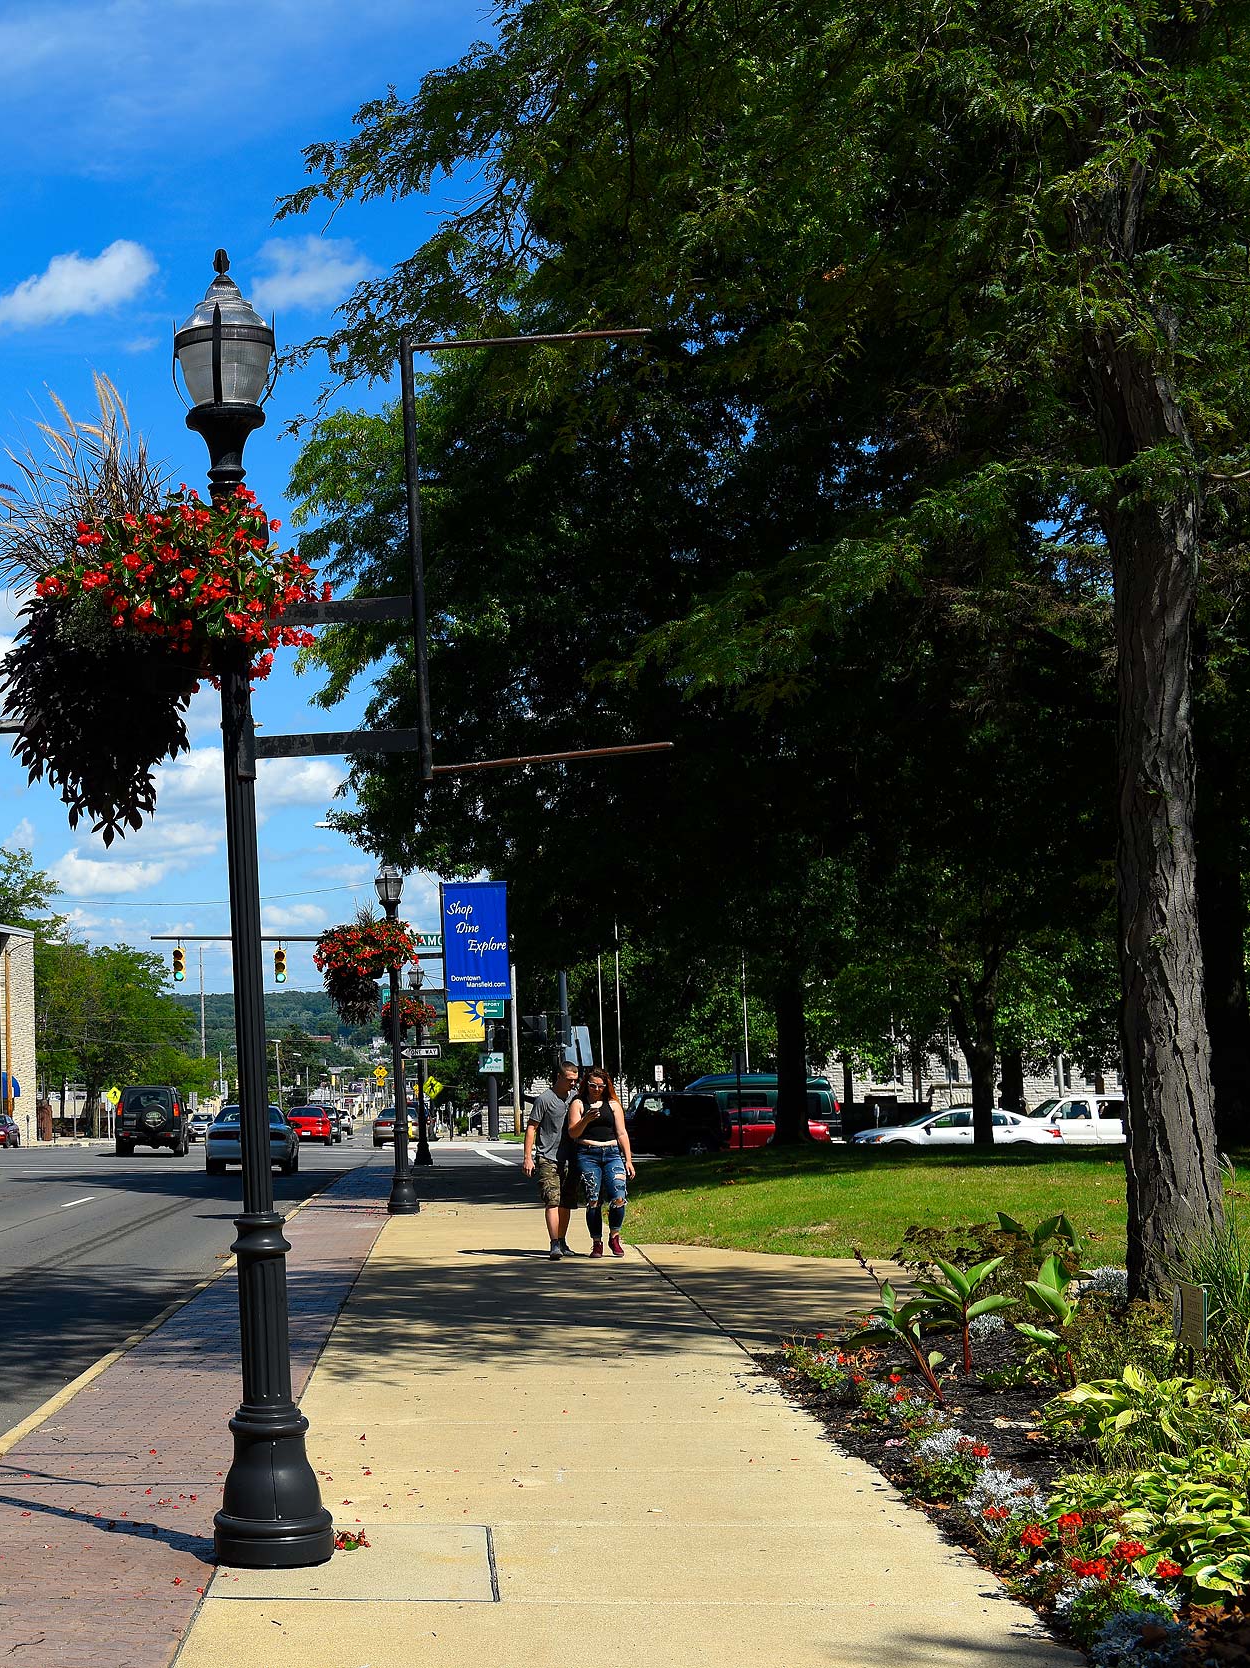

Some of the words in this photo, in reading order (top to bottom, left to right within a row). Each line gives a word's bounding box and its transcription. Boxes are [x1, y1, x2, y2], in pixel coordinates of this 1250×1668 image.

[446, 900, 473, 920] Shop
[455, 921, 479, 933] Dine
[467, 936, 507, 958] Explore
